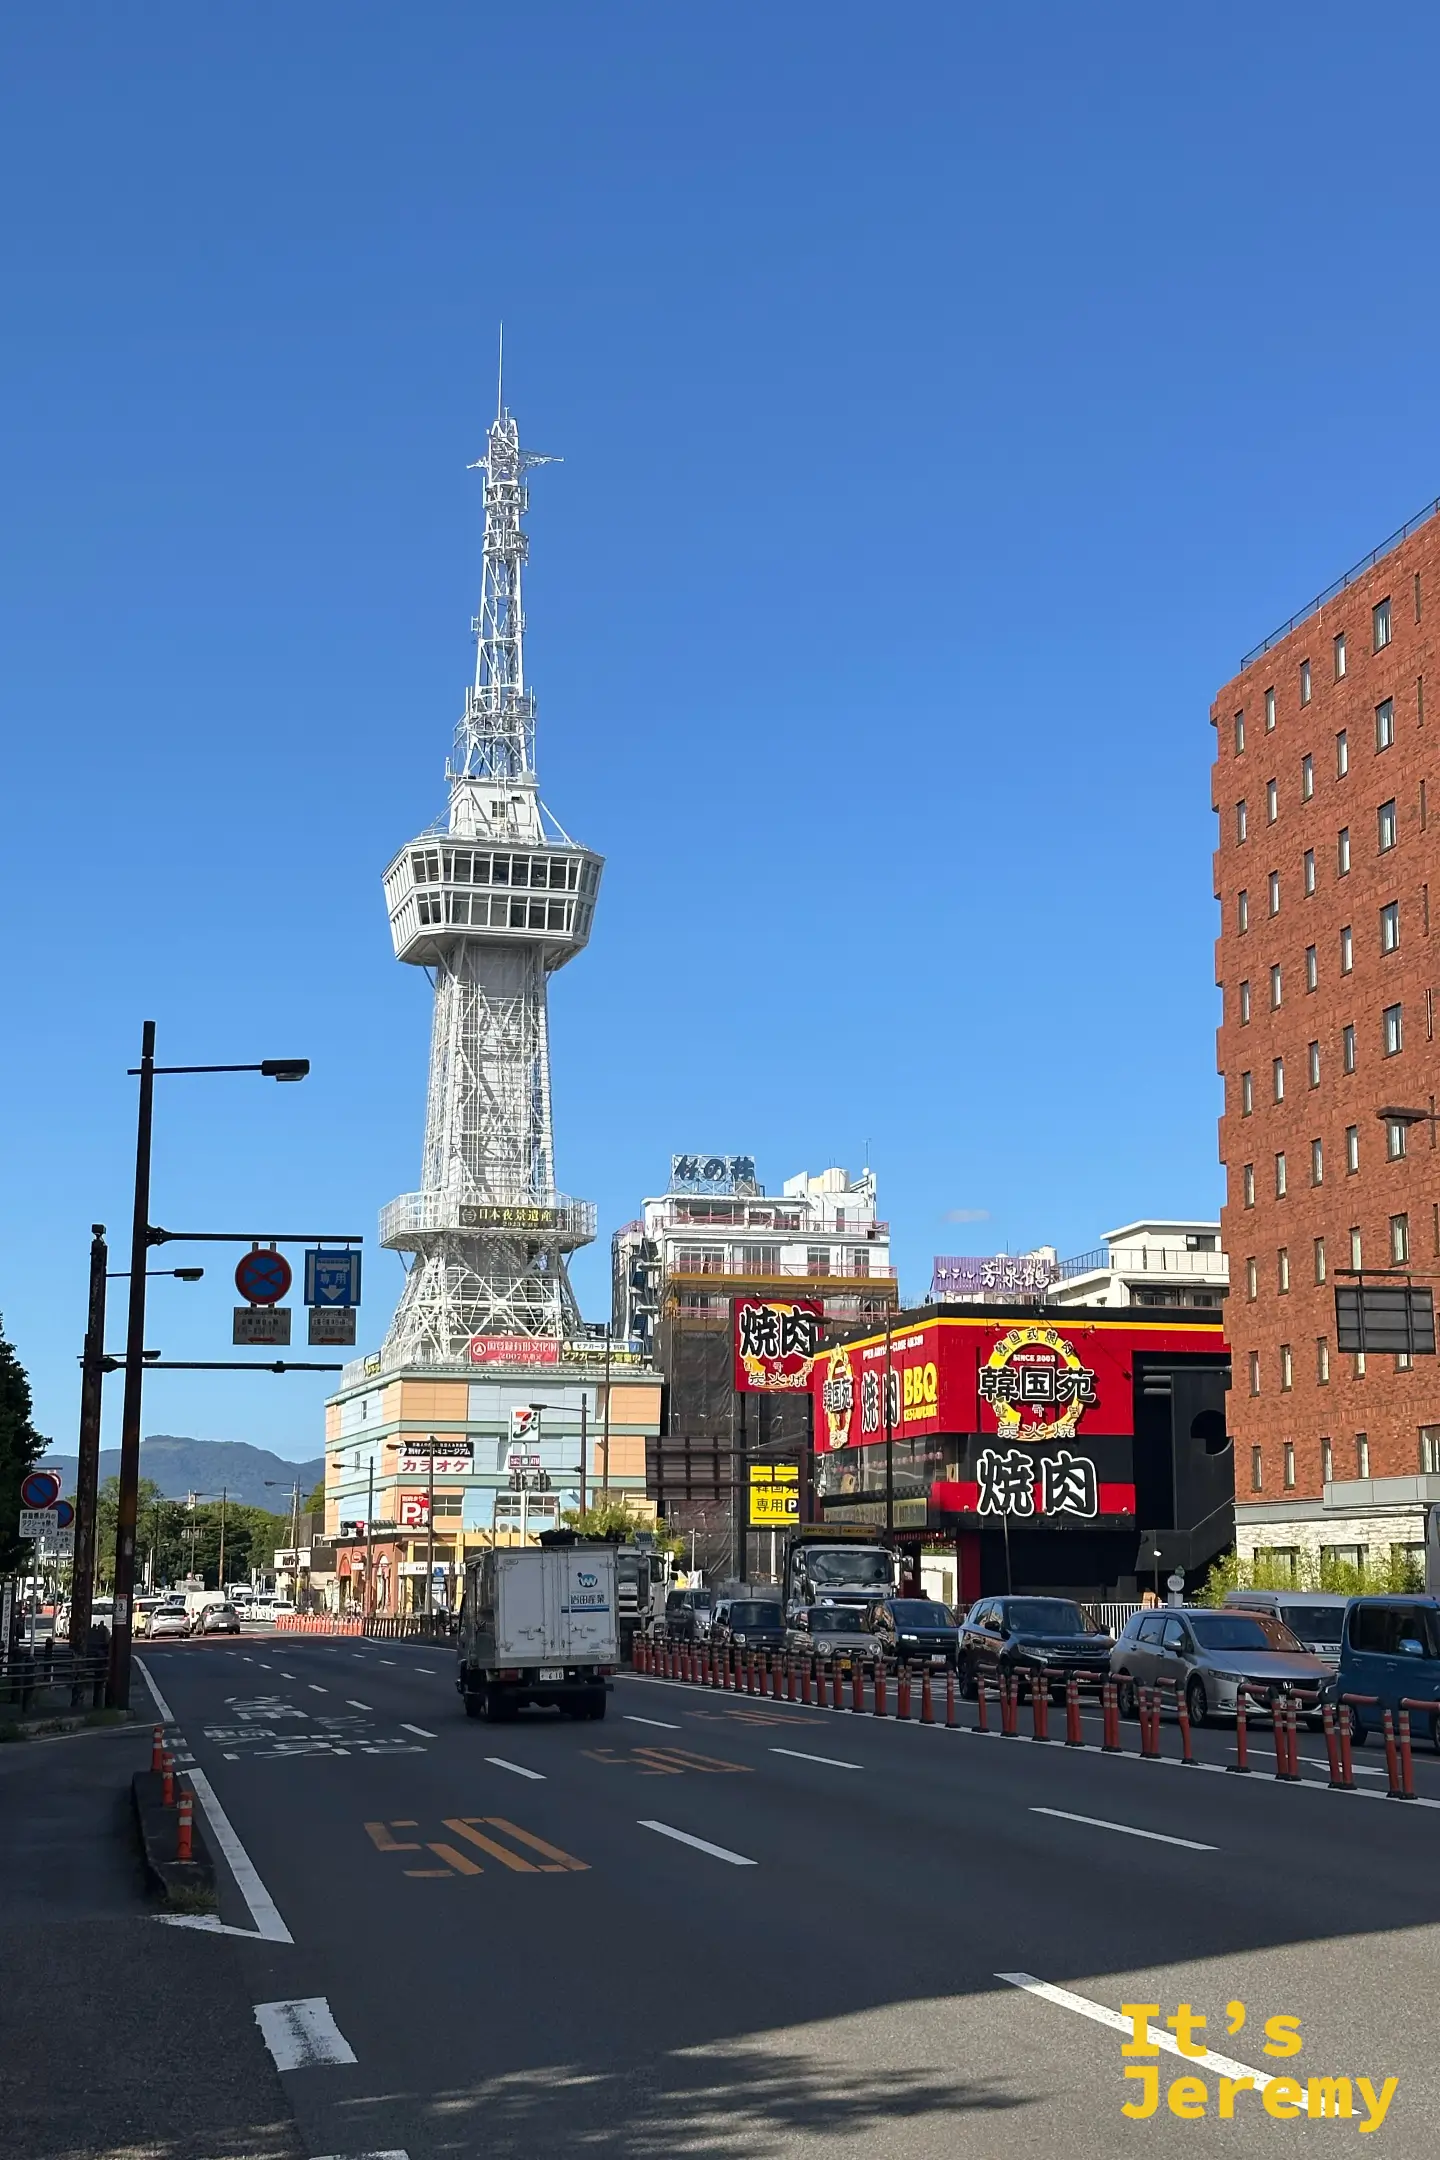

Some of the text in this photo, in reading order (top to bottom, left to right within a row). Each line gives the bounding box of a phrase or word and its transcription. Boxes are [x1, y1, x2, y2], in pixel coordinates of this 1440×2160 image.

[479, 1208, 553, 1222] 日本夜景遺産
[739, 1304, 818, 1360] 焼肉
[1013, 1354, 1056, 1362] SINCE 2003
[748, 1372, 808, 1388] 炭火焼
[904, 1362, 938, 1406] BBQ
[978, 1365, 1097, 1403] 韓国苑
[997, 1422, 1076, 1439] 炭火焼
[402, 1459, 469, 1472] カラオケ
[977, 1449, 1098, 1518] 焼肉
[756, 1498, 783, 1512] 専用
[579, 1747, 756, 1775] 50
[363, 1817, 592, 1877] 50
